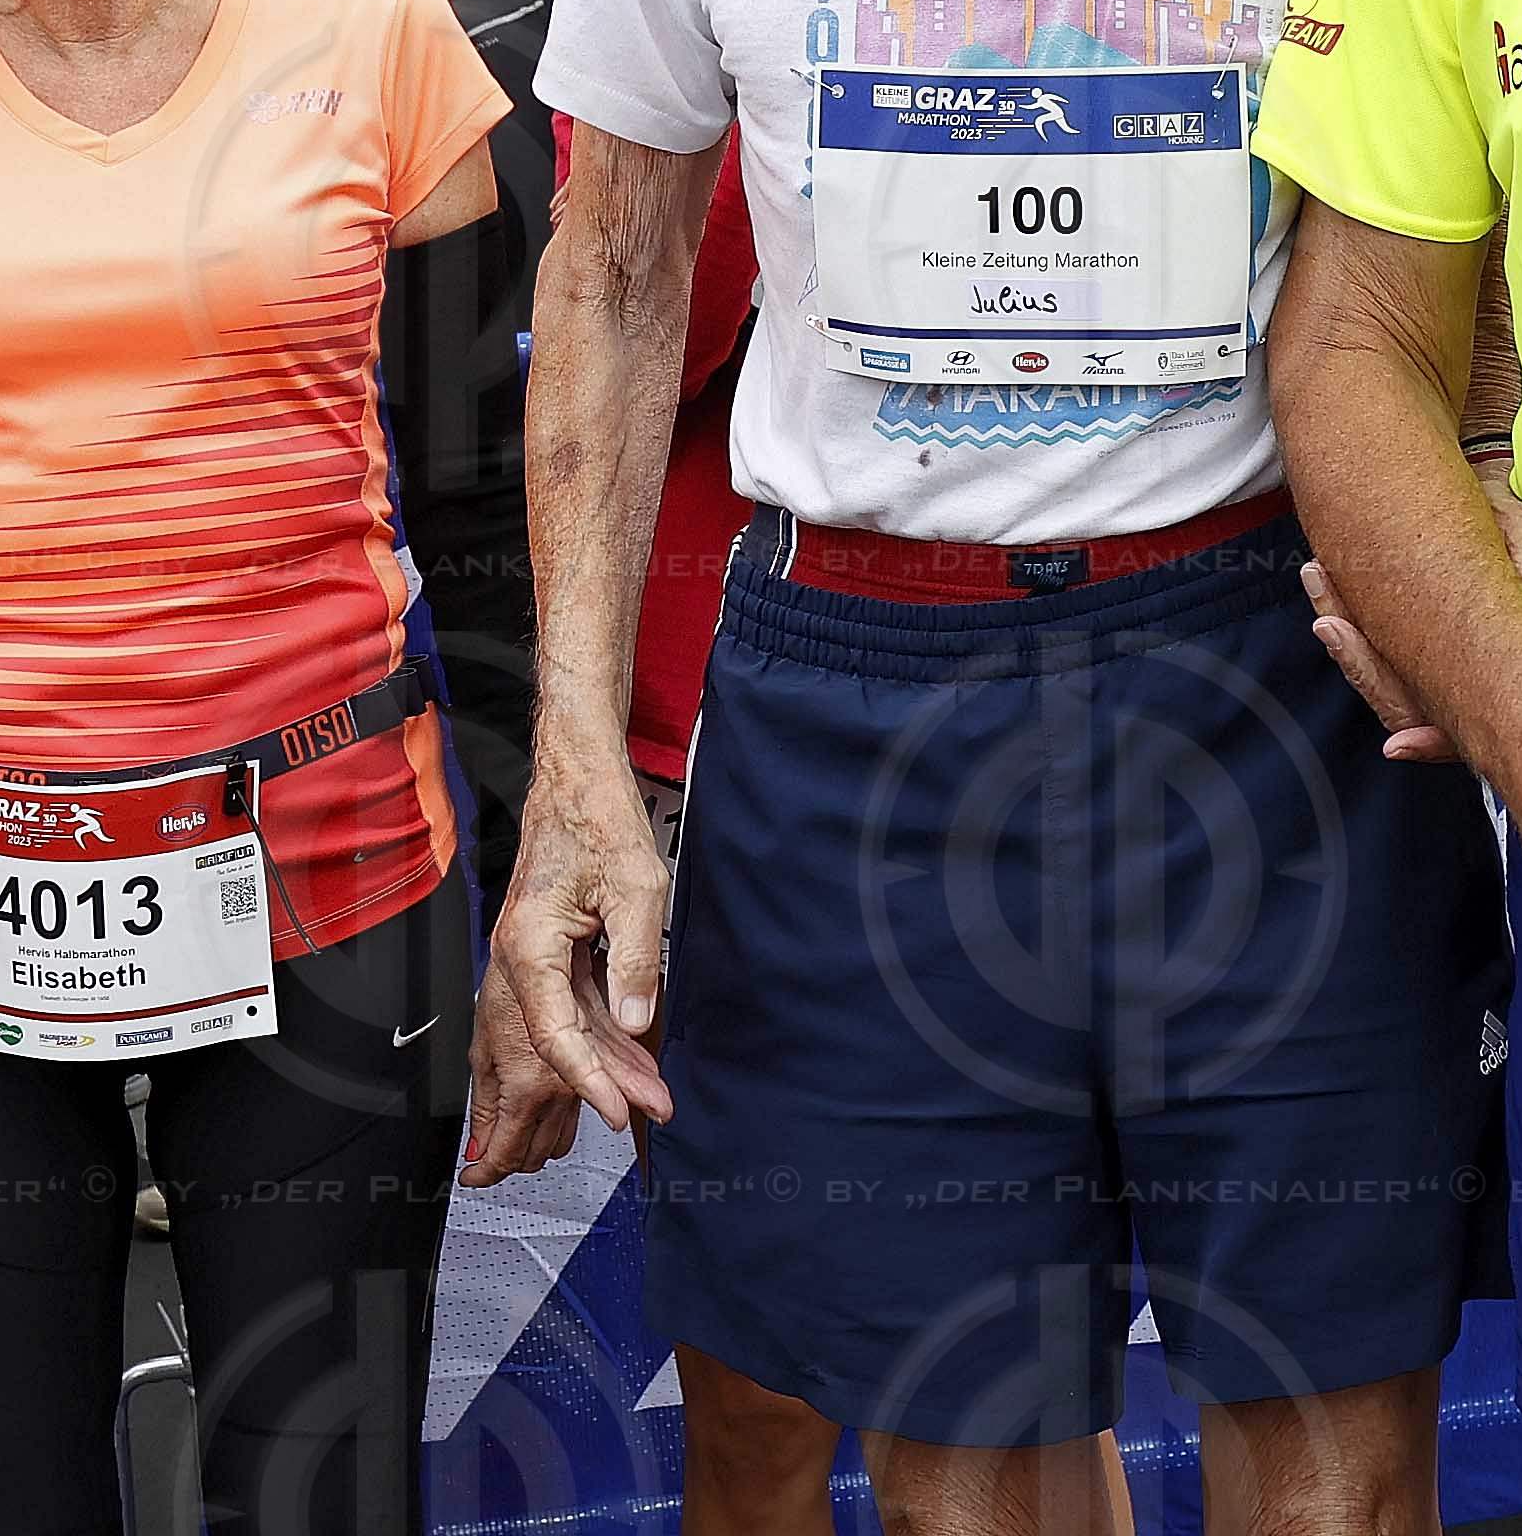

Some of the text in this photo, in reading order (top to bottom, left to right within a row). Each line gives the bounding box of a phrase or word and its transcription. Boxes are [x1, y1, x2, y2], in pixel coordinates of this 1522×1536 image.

[875, 88, 909, 98] KLEINE
[914, 87, 1015, 112] GRAZ 30
[897, 112, 971, 126] MARATHON
[1115, 115, 1203, 138] GRAZ
[951, 127, 983, 140] 2023
[1168, 135, 1204, 144] HOLDING
[977, 186, 1083, 235] 100
[922, 251, 1139, 271] Kleine Zeitung Marathon
[970, 284, 1058, 314] Julius
[281, 705, 354, 767] OTSO
[162, 811, 206, 834] Hervis
[8, 834, 32, 847] 2023
[18, 945, 135, 959] Hervis Halbmarathon
[12, 960, 146, 989] Elisabeth
[1480, 1039, 1508, 1075] adid
